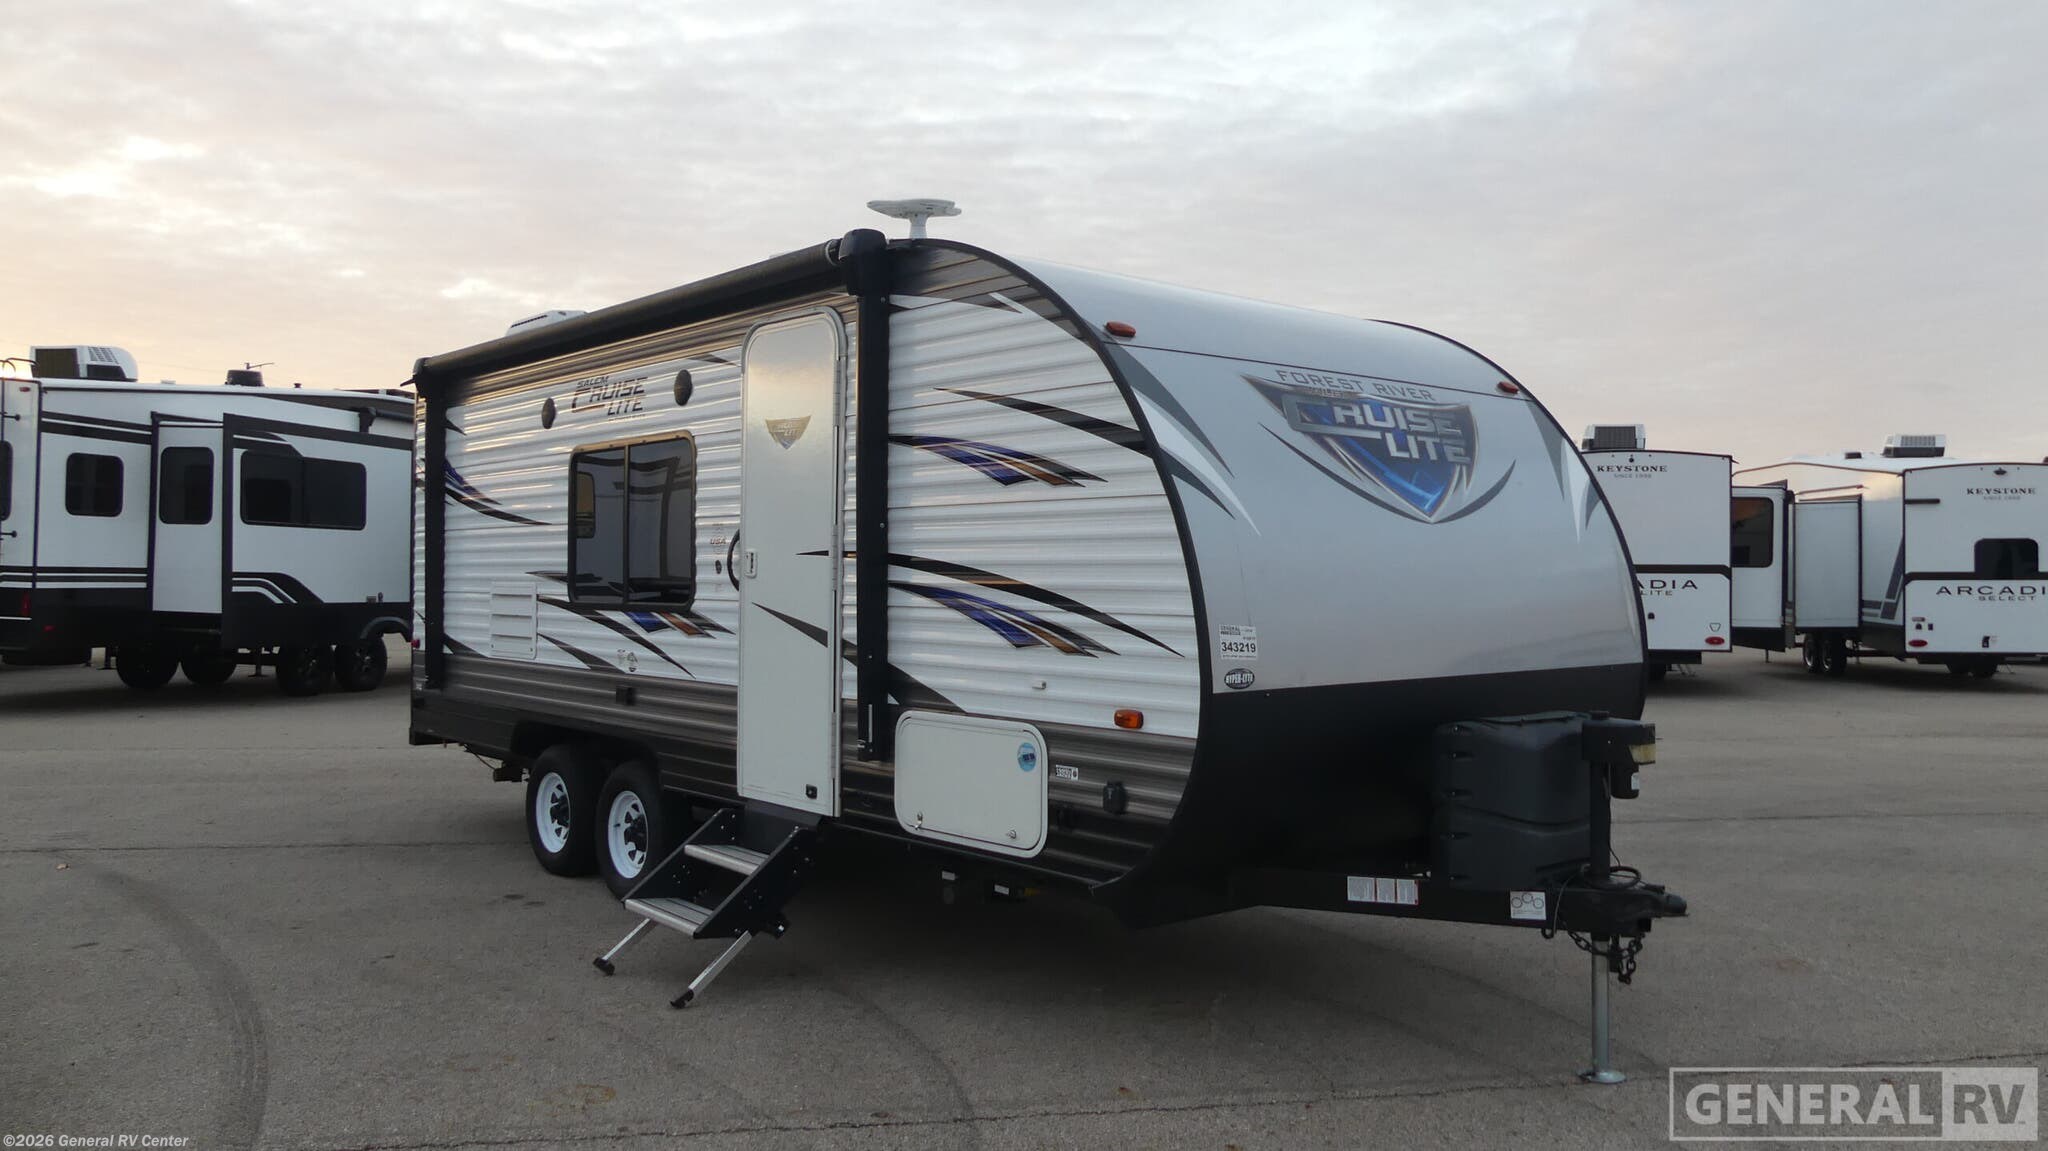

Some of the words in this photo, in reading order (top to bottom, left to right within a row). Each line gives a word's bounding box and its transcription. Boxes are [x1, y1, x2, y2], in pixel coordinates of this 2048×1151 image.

[576, 376, 609, 388] SALEM
[1276, 369, 1364, 392] FOREST
[1373, 382, 1436, 401] RIVER
[571, 377, 649, 413] CRUISE
[607, 396, 644, 416] LITE
[1281, 394, 1463, 440] CRUISE
[1385, 431, 1471, 465] LITE
[1597, 465, 1668, 473] KEYSTONE
[1966, 487, 2036, 495] KEYSTONE
[1221, 642, 1256, 653] 343219
